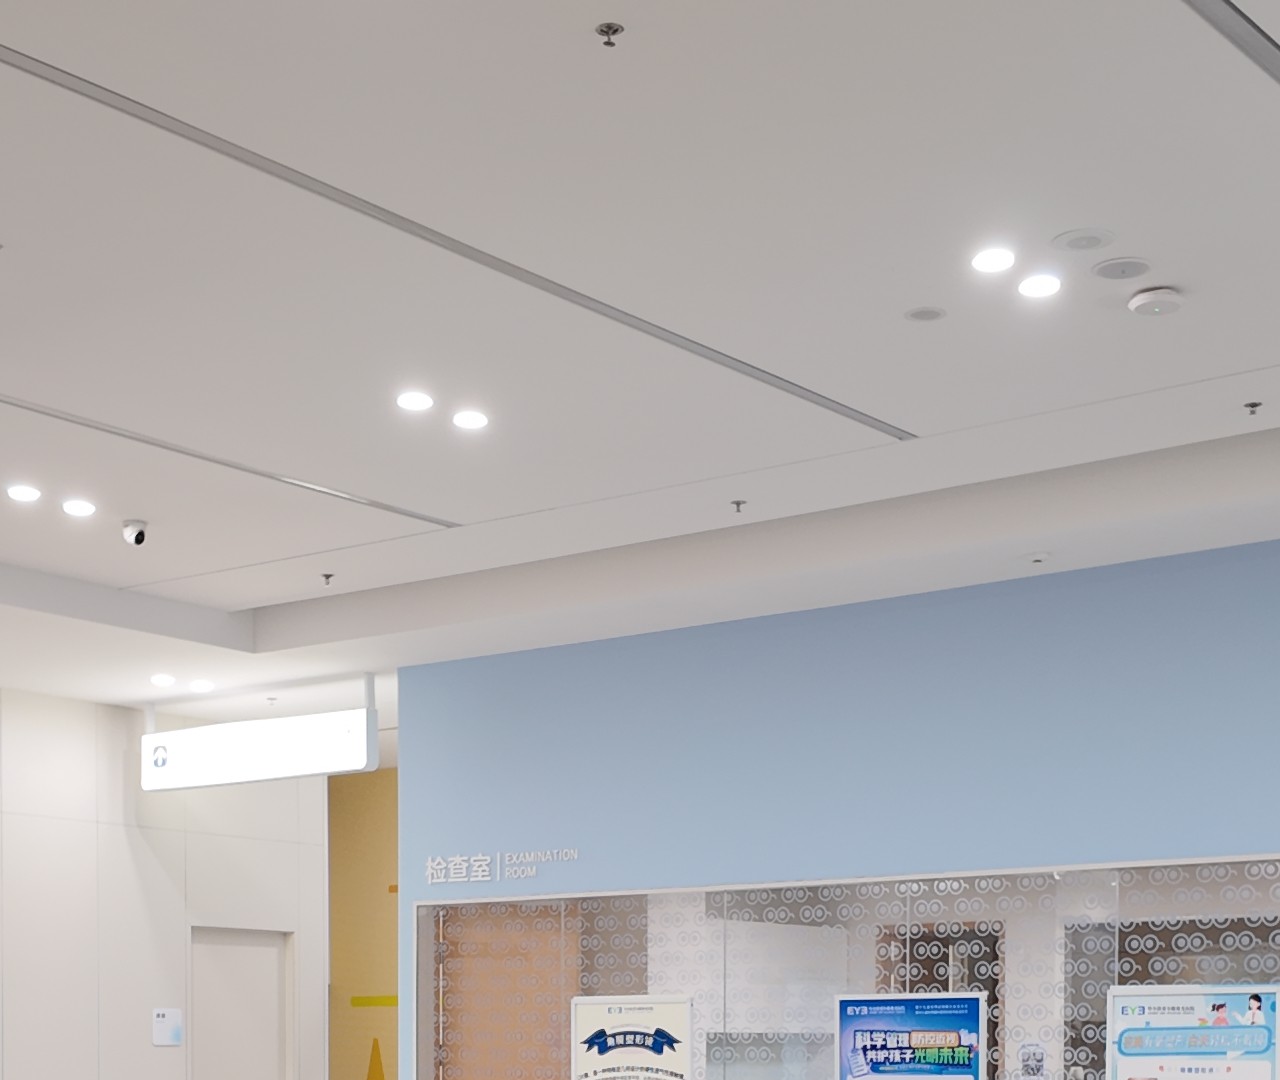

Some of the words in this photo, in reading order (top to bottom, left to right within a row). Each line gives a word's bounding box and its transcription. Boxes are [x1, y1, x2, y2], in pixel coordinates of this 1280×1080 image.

[505, 848, 578, 865] EXAMINATION
[425, 853, 493, 885] 检查室
[505, 866, 536, 879] ROOM
[855, 1031, 910, 1049] 科学管理
